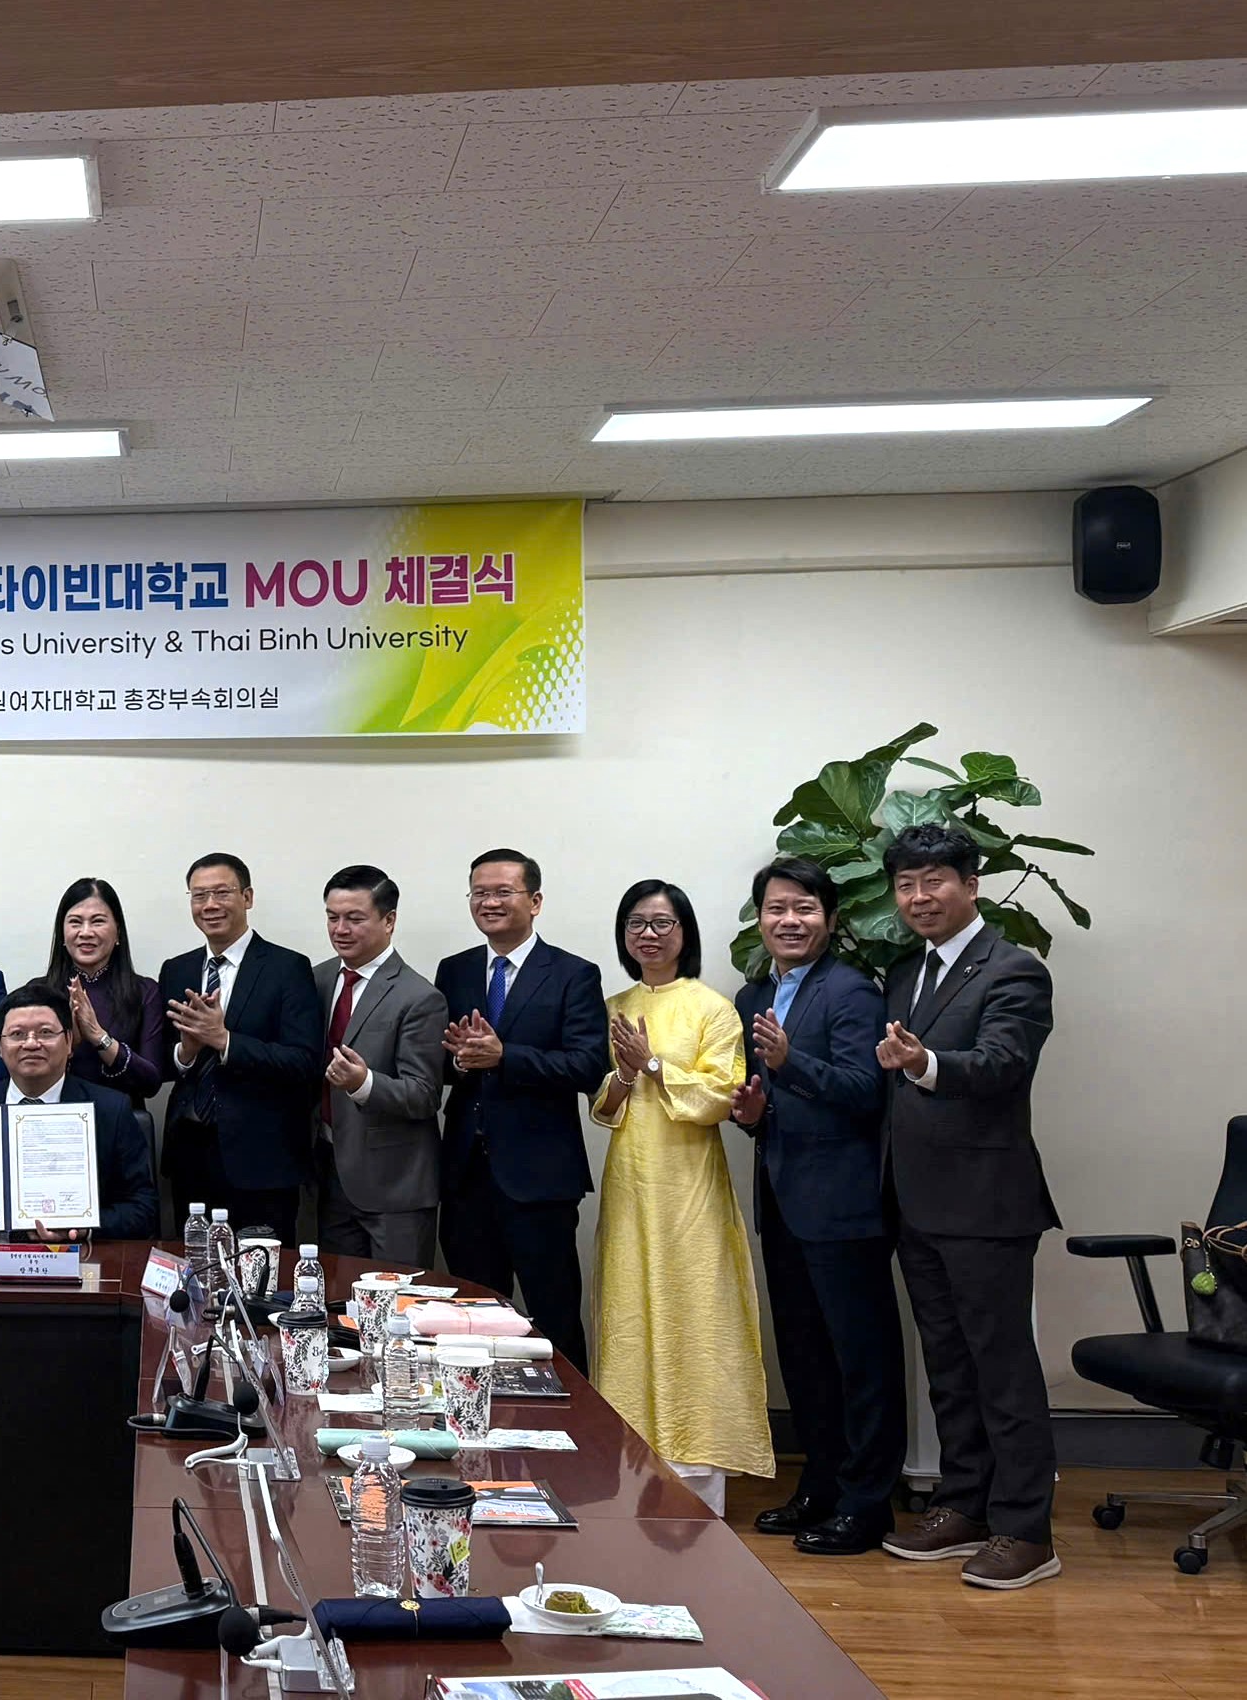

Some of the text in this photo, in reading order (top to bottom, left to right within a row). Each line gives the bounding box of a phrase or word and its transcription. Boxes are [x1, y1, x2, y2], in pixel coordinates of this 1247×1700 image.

[244, 559, 369, 608] MOU
[384, 554, 515, 605] 체결식
[23, 630, 157, 660] University
[164, 630, 183, 653] &
[191, 628, 250, 652] Thai
[259, 626, 318, 651] Binh
[327, 624, 469, 655] University
[124, 686, 279, 711] 총장부속회의실
